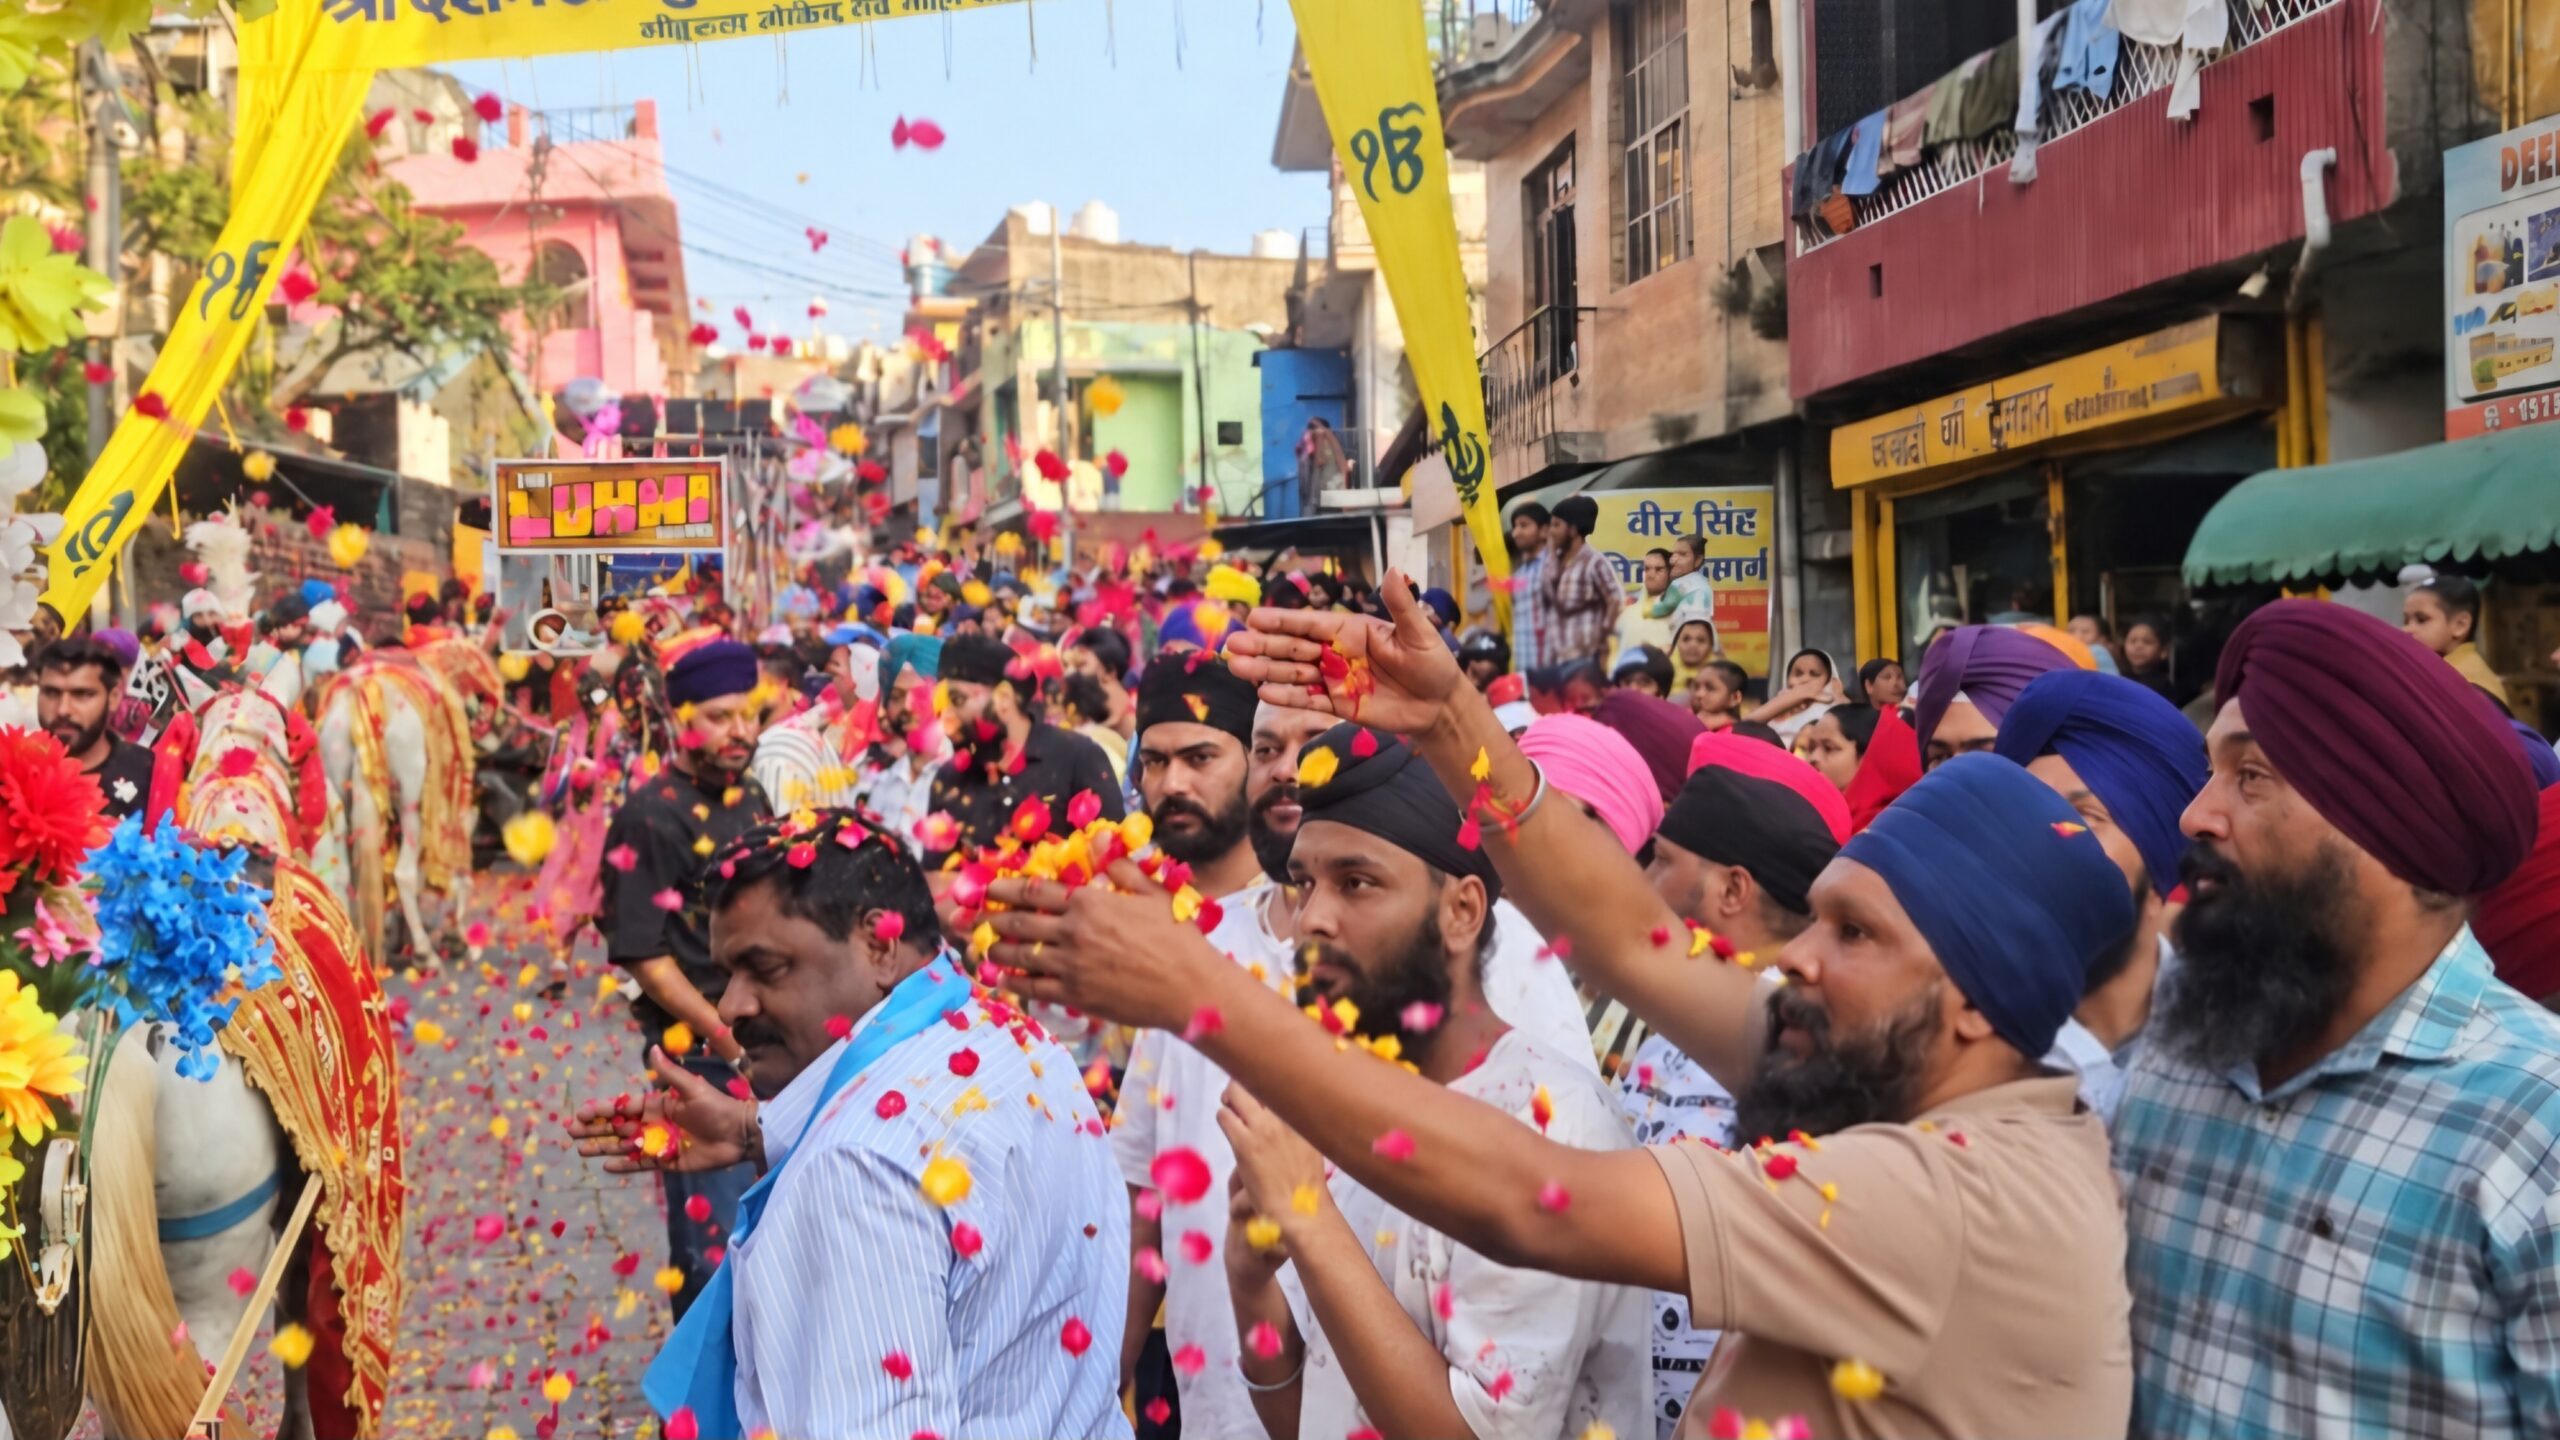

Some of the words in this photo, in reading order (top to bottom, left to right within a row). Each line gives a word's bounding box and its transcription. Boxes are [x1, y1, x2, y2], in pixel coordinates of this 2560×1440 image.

[2501, 128, 2560, 193] DEE
[1627, 500, 1683, 536] वीर
[1692, 500, 1758, 537] सिंह
